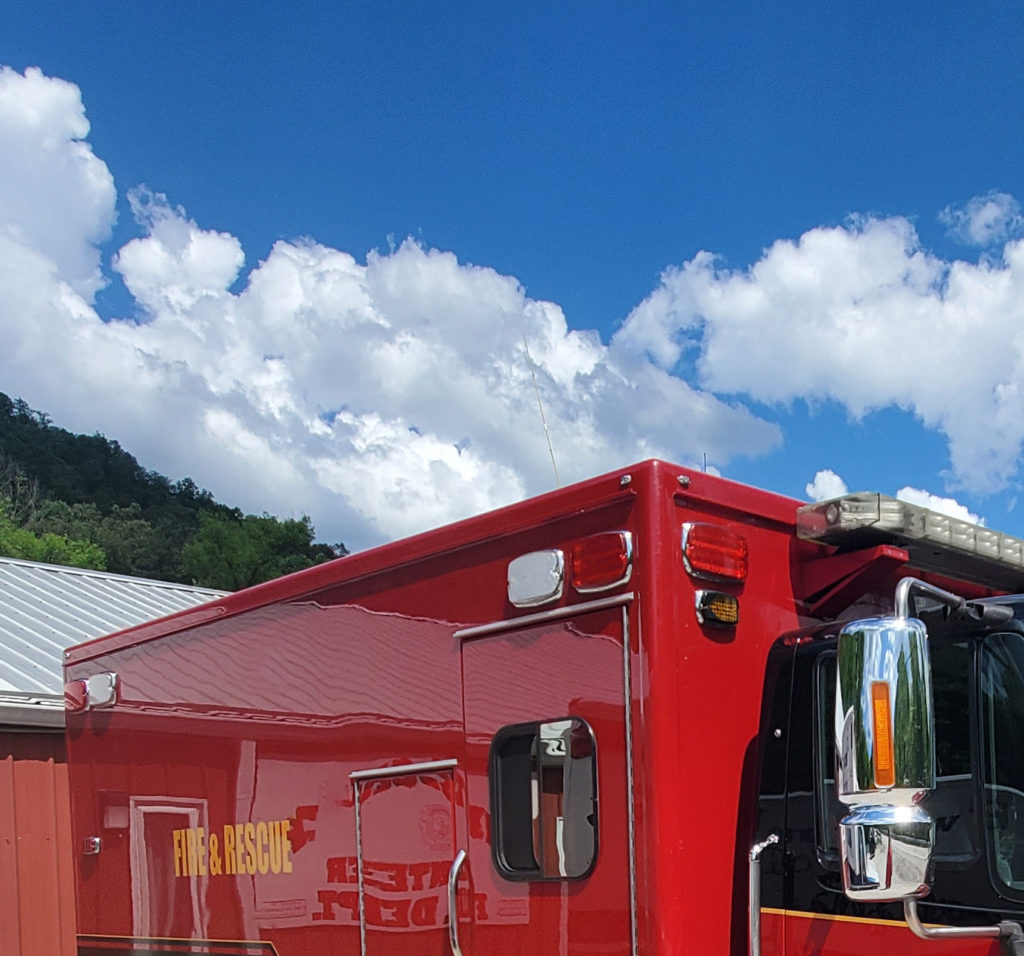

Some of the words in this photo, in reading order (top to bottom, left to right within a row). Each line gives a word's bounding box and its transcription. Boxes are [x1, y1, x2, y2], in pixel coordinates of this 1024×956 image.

[173, 827, 208, 877] FIRE
[209, 833, 222, 876] &
[224, 820, 293, 875] RESCUE
